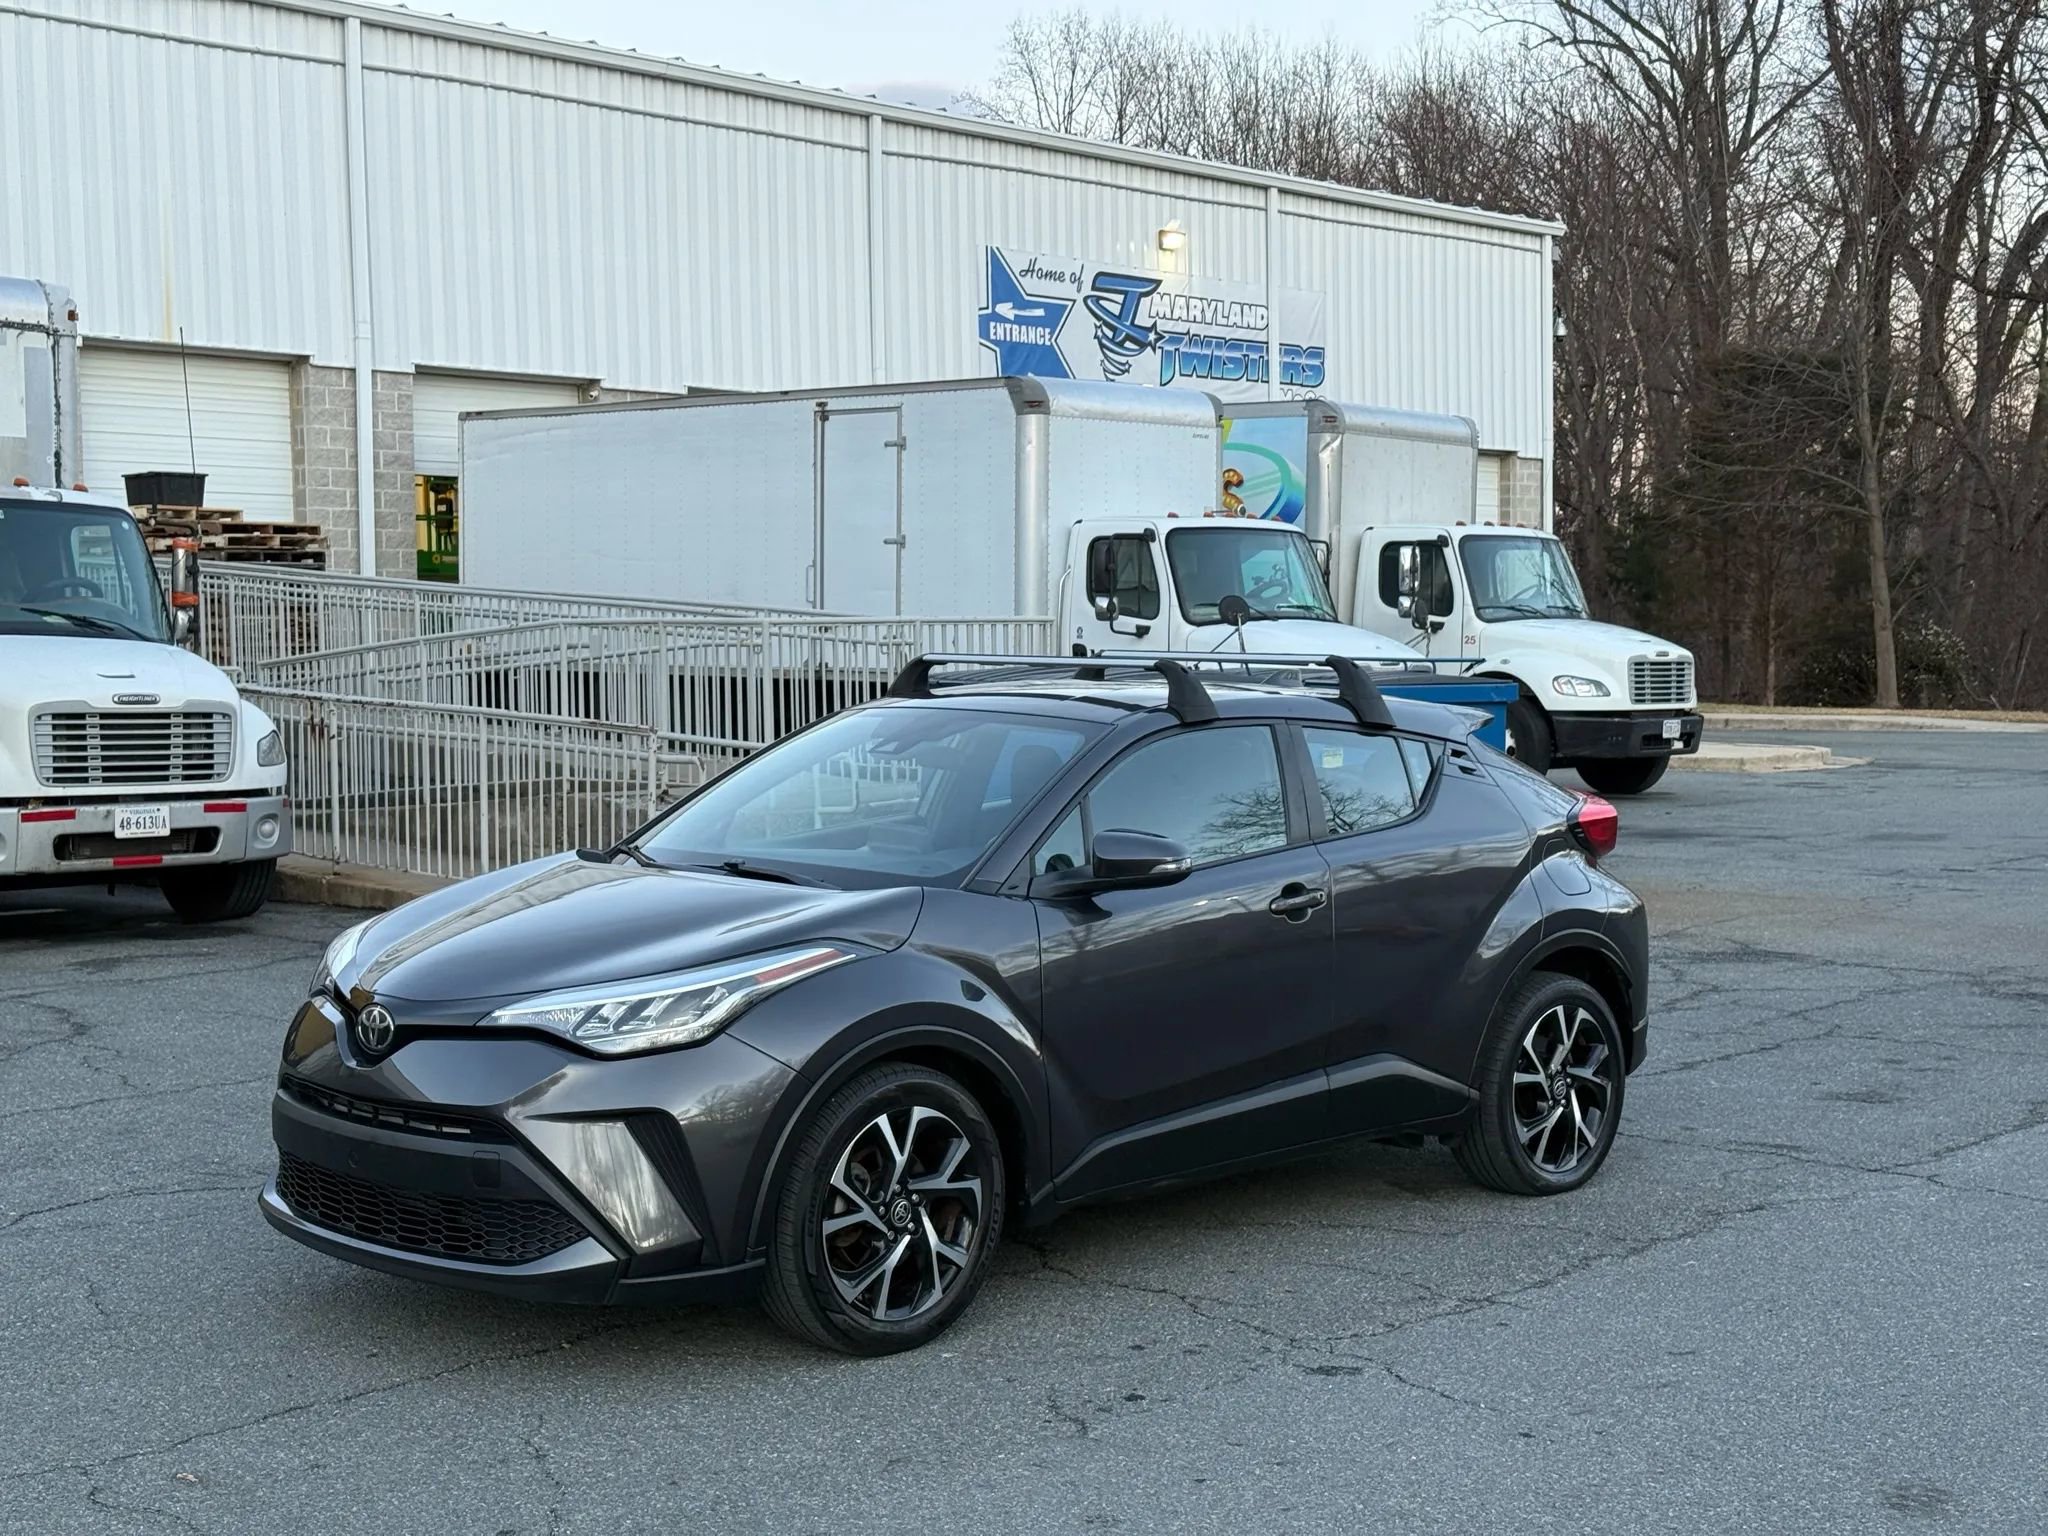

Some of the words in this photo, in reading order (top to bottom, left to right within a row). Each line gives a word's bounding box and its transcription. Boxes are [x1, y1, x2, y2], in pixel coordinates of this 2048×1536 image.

[1019, 257, 1066, 283] Home
[1070, 263, 1084, 294] of
[1148, 291, 1269, 331] MARYLAND
[989, 321, 1052, 346] ENTRANCE
[1158, 328, 1325, 388] TWISTRS
[1463, 635, 1477, 645] 25
[119, 815, 168, 831] 48-613UA
